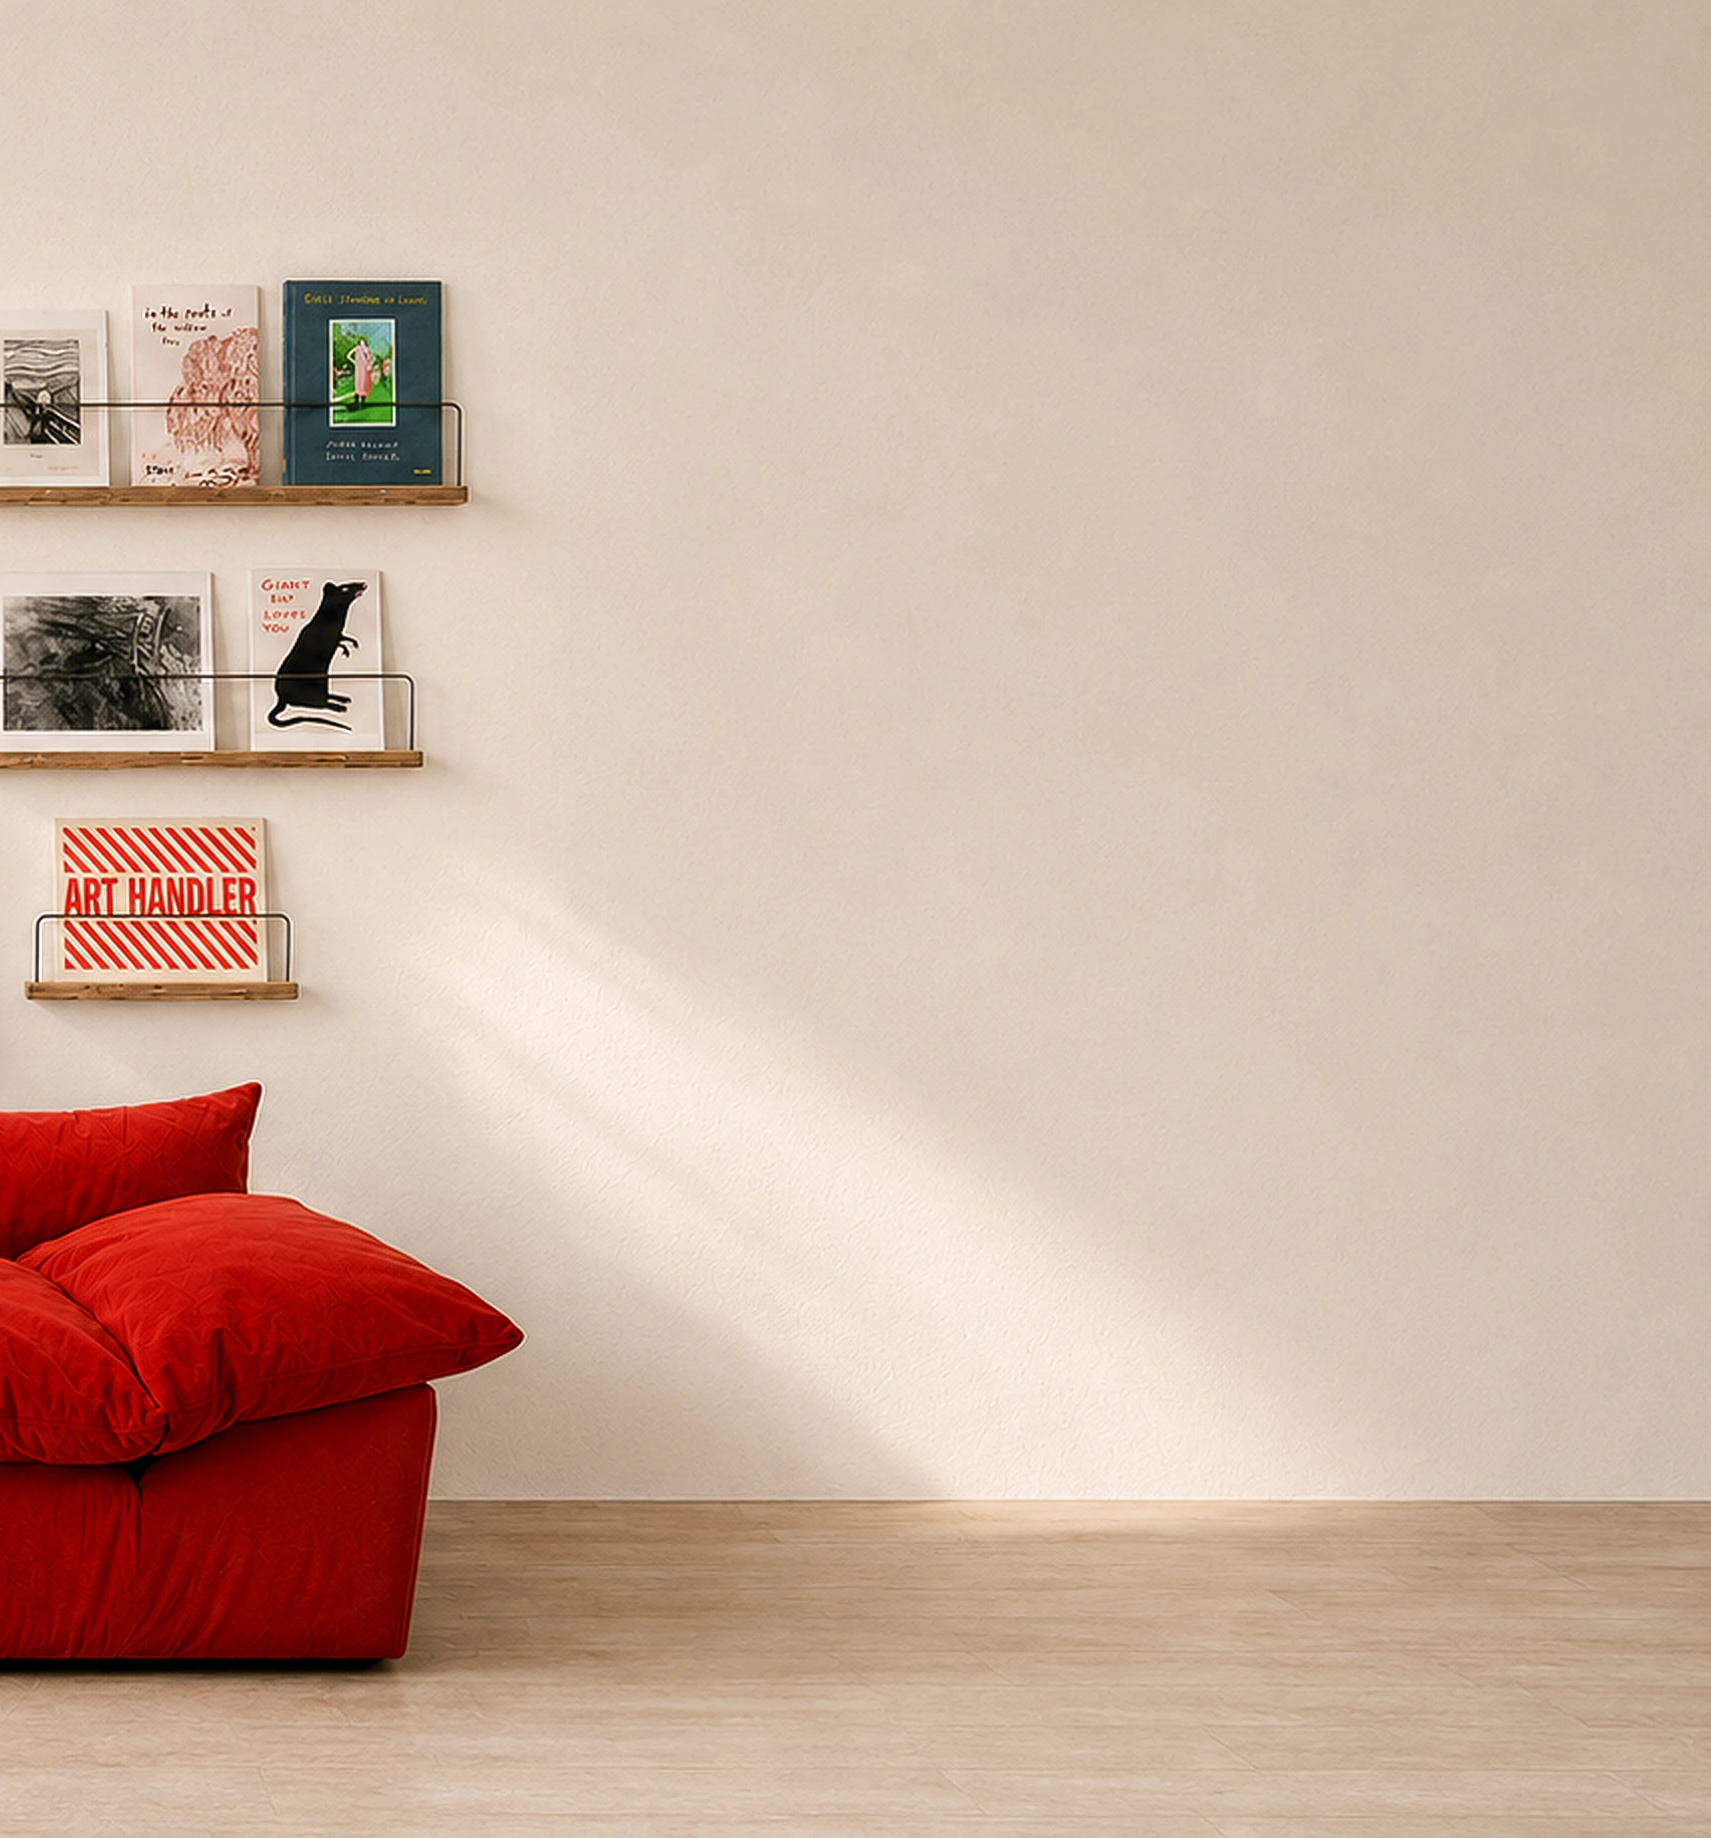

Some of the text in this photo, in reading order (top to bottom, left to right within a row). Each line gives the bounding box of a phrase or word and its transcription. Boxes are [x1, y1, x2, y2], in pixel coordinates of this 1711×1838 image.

[262, 623, 289, 633] YOU
[64, 877, 257, 916] ART HANDLER
